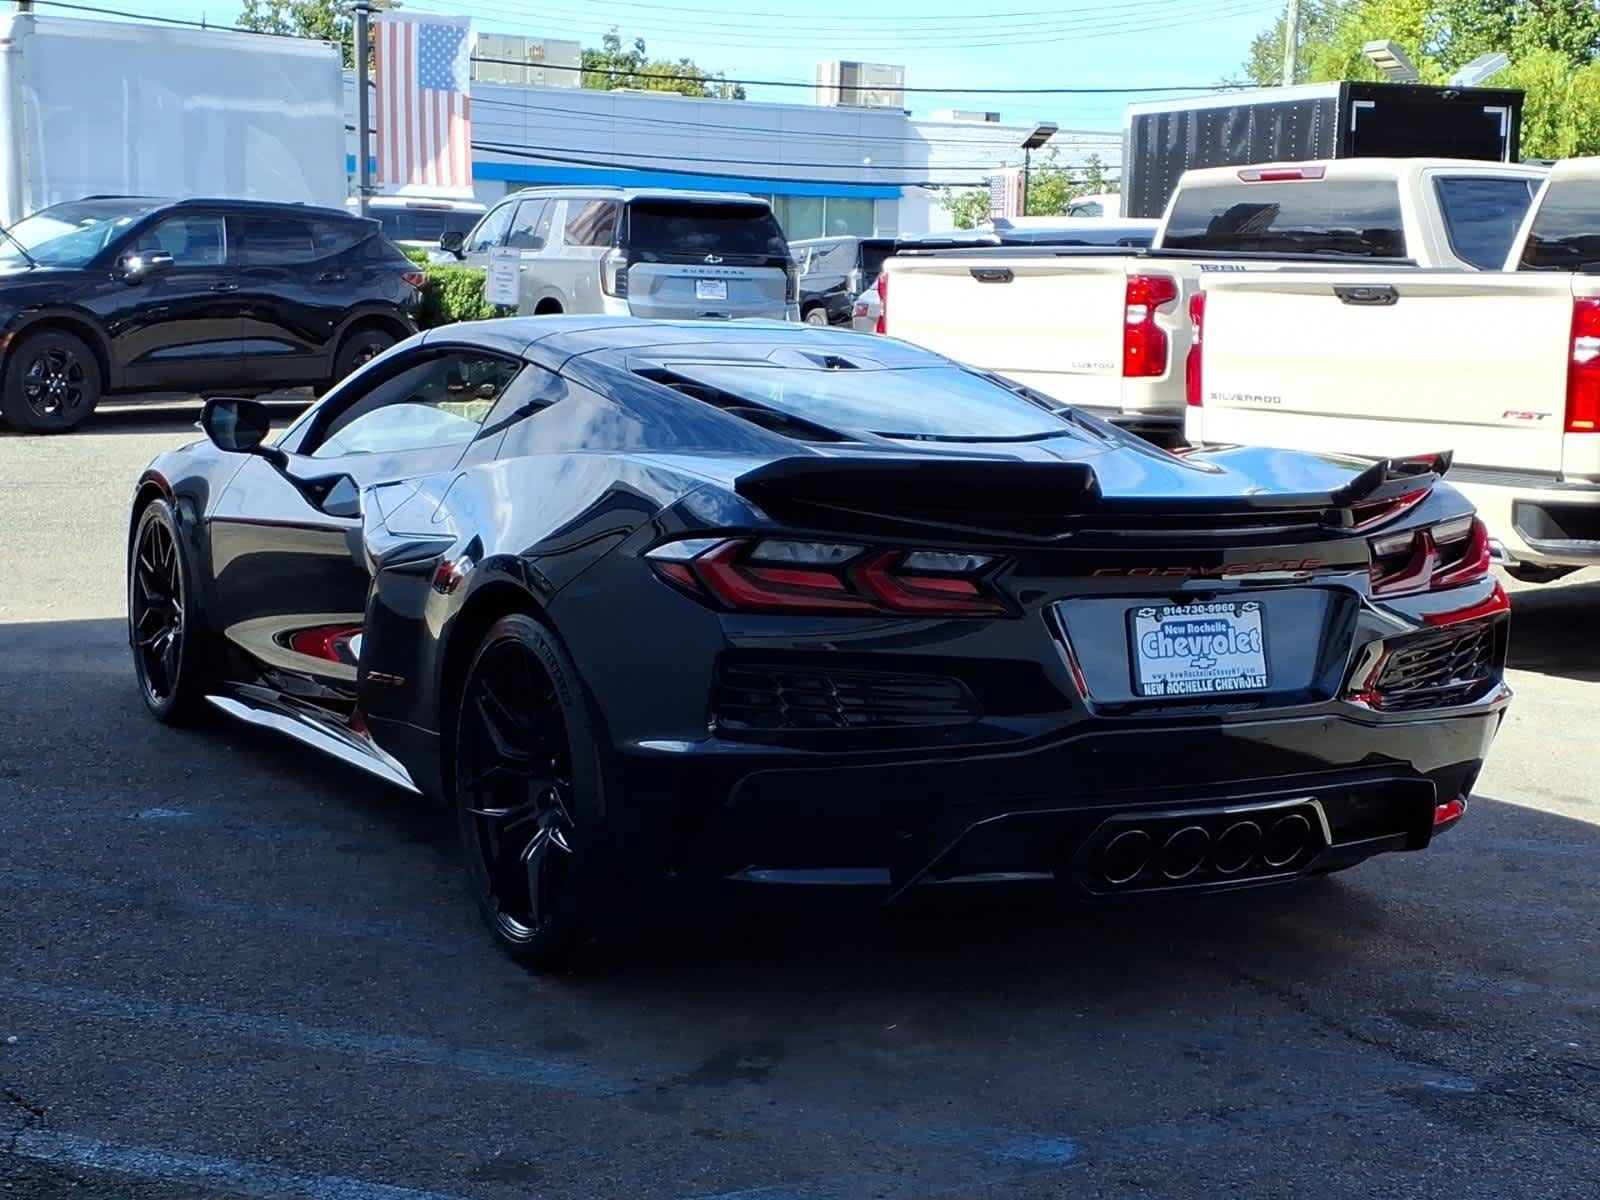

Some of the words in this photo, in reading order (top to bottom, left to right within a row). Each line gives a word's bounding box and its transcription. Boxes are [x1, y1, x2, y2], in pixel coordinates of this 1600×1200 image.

[1211, 392, 1281, 403] SILVERADO
[1164, 624, 1186, 635] New
[1187, 621, 1227, 634] Rochelle
[1141, 626, 1261, 660] Chevrolet
[1144, 683, 1165, 696] NEW
[1166, 678, 1214, 696] ROCHELLE
[1215, 674, 1267, 692] CHEVROLET
